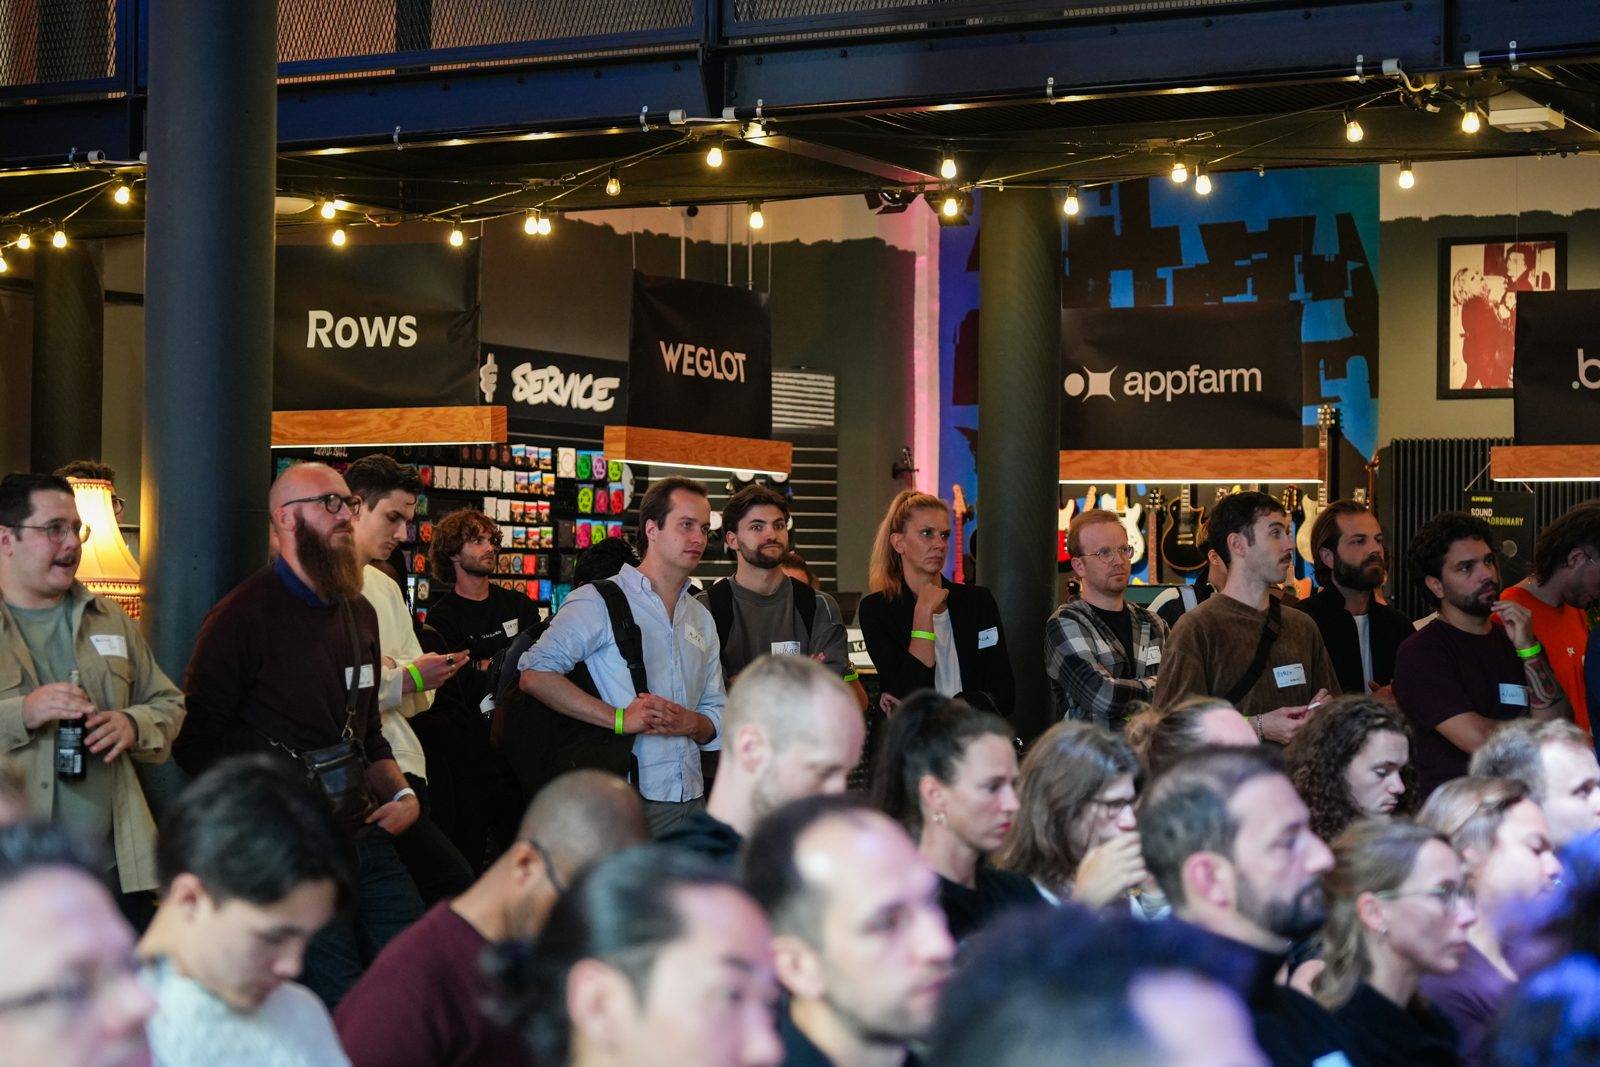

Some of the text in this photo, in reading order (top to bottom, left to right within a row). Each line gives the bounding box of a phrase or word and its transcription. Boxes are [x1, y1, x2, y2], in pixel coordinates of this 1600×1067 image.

[659, 340, 746, 383] WEGLOT
[511, 362, 620, 412] SERVICE
[1122, 365, 1263, 403] appfarm
[1470, 508, 1493, 517] SOUND
